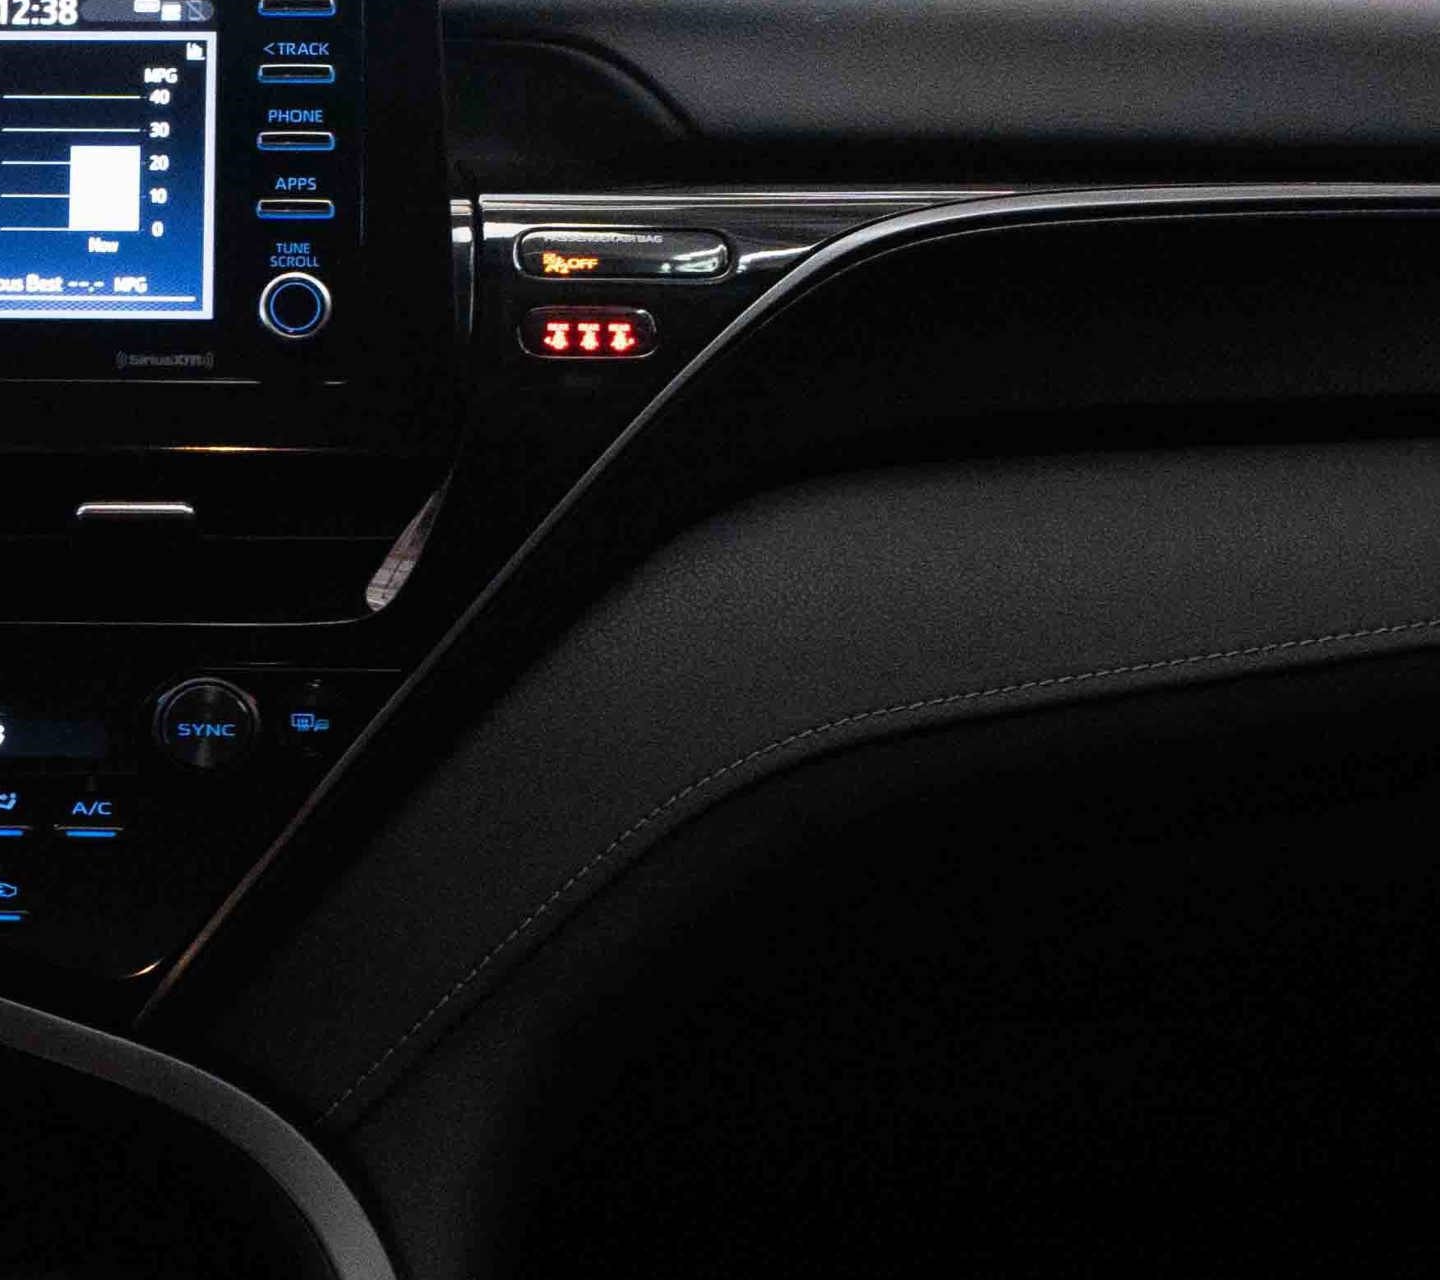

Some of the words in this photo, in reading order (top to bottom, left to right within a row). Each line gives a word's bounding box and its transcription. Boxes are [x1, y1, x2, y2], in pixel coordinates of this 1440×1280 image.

[143, 67, 178, 84] MPG
[148, 88, 171, 105] 40
[268, 109, 324, 123] PHONE
[148, 122, 170, 138] 30
[148, 154, 170, 171] 20
[274, 177, 317, 191] APPS
[149, 187, 168, 205] 10
[151, 220, 164, 238] 0
[87, 236, 120, 254] Now
[275, 242, 311, 254] TUNE
[269, 255, 320, 268] SCROLL
[567, 257, 599, 270] OFF
[25, 273, 64, 293] Best
[113, 276, 148, 294] MPG
[176, 722, 238, 737] SYNC
[71, 800, 113, 816] A/C
